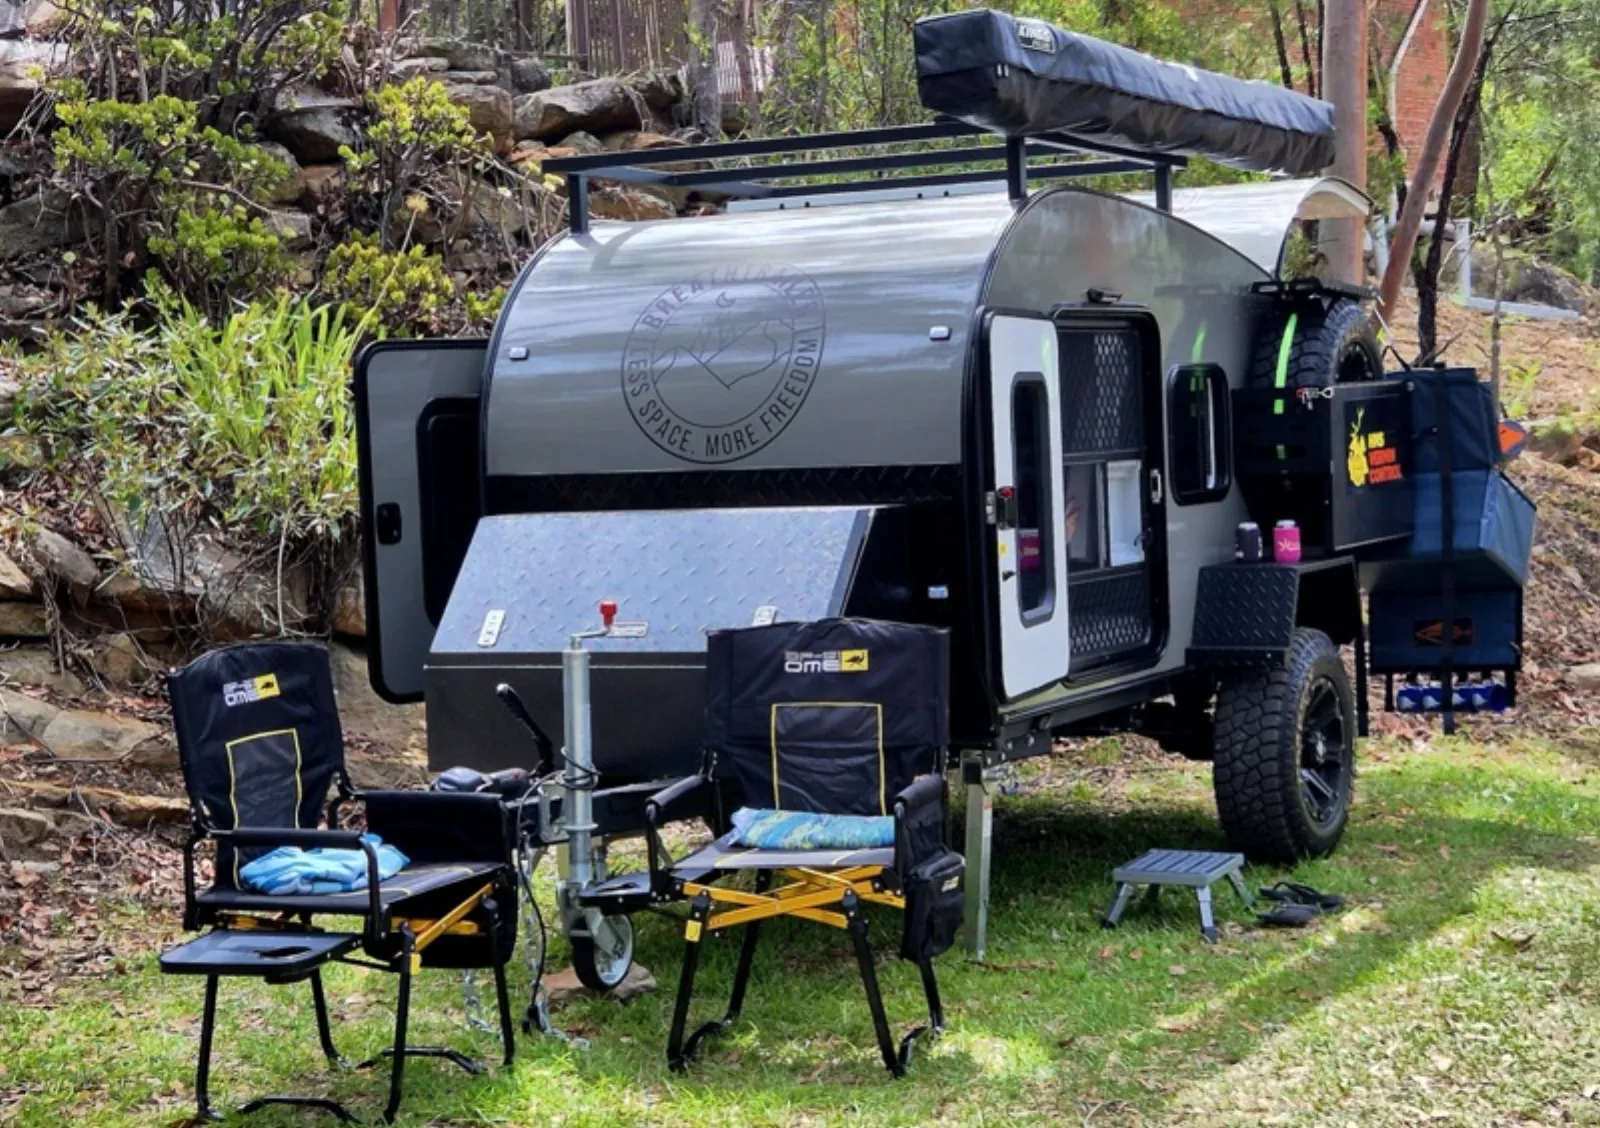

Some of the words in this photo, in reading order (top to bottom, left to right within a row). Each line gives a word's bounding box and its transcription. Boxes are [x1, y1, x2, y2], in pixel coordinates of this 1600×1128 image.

[628, 345, 650, 397] LESS
[705, 423, 759, 457] MORE
[759, 338, 818, 433] FREEDOM
